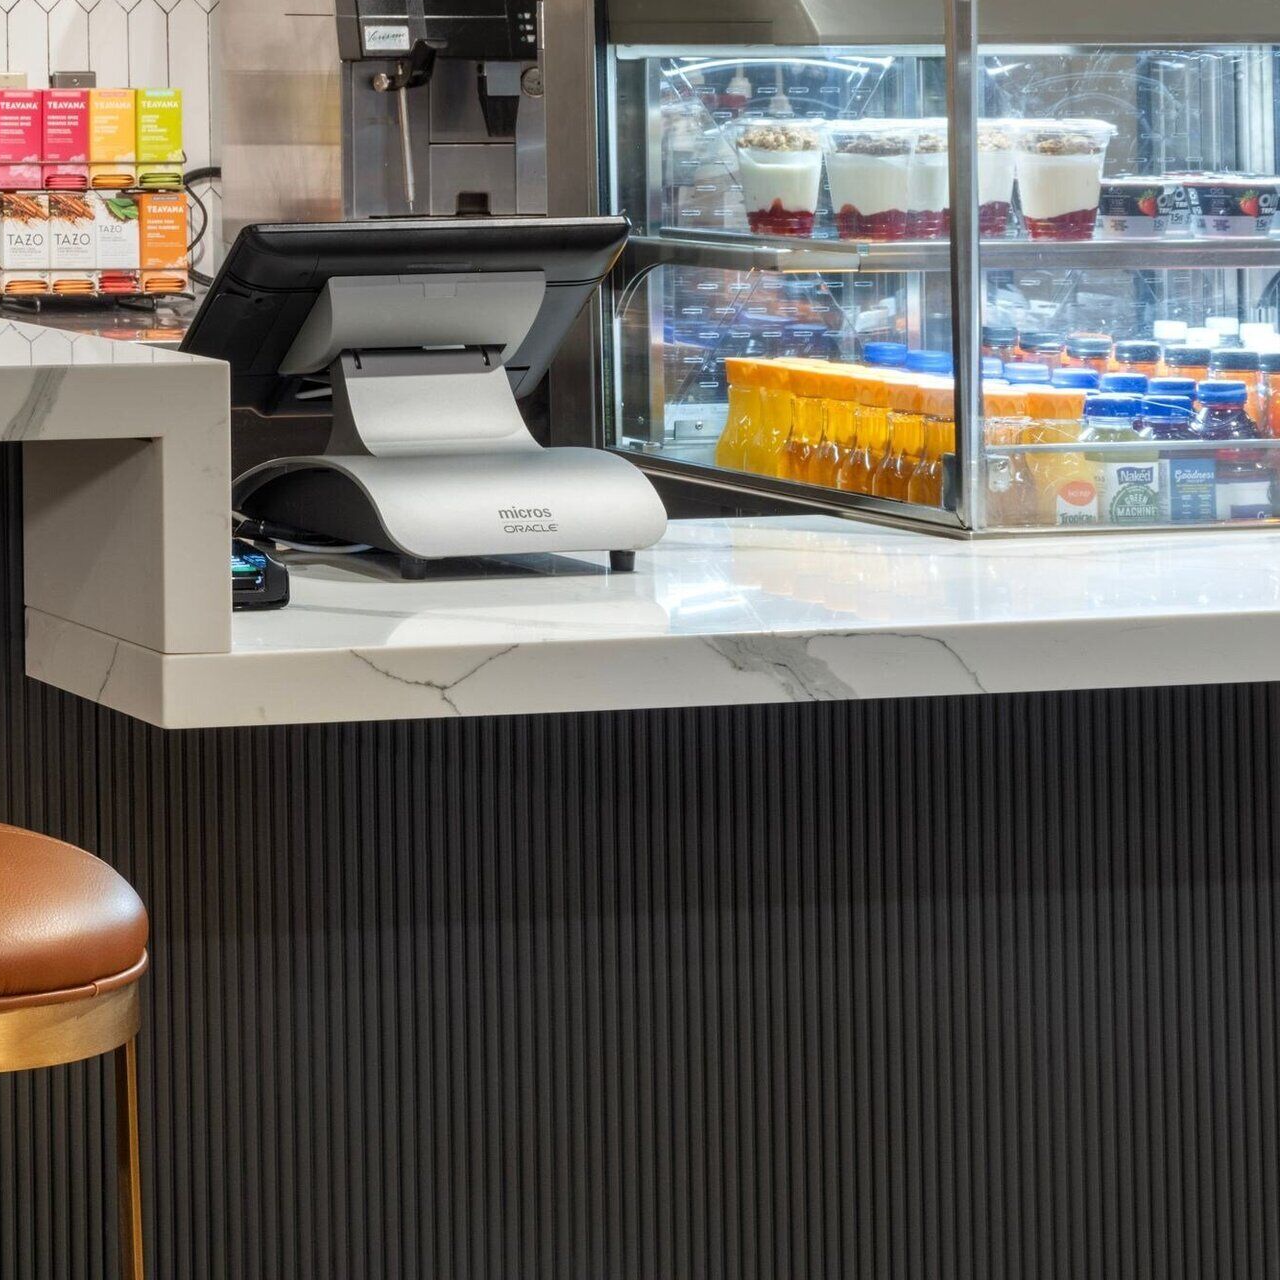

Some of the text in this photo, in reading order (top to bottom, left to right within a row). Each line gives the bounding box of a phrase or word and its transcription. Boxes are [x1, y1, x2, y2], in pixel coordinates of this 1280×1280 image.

[0, 101, 38, 110] TEAVANA
[47, 101, 85, 110] TEAVANA
[141, 100, 179, 109] TEAVANA
[147, 205, 184, 214] TEAVANA
[98, 224, 123, 233] TAZO
[6, 233, 44, 246] TAZO
[53, 233, 91, 246] TAZO
[1124, 493, 1149, 505] GREEN
[498, 506, 552, 519] micros
[503, 523, 559, 533] ORACLE
